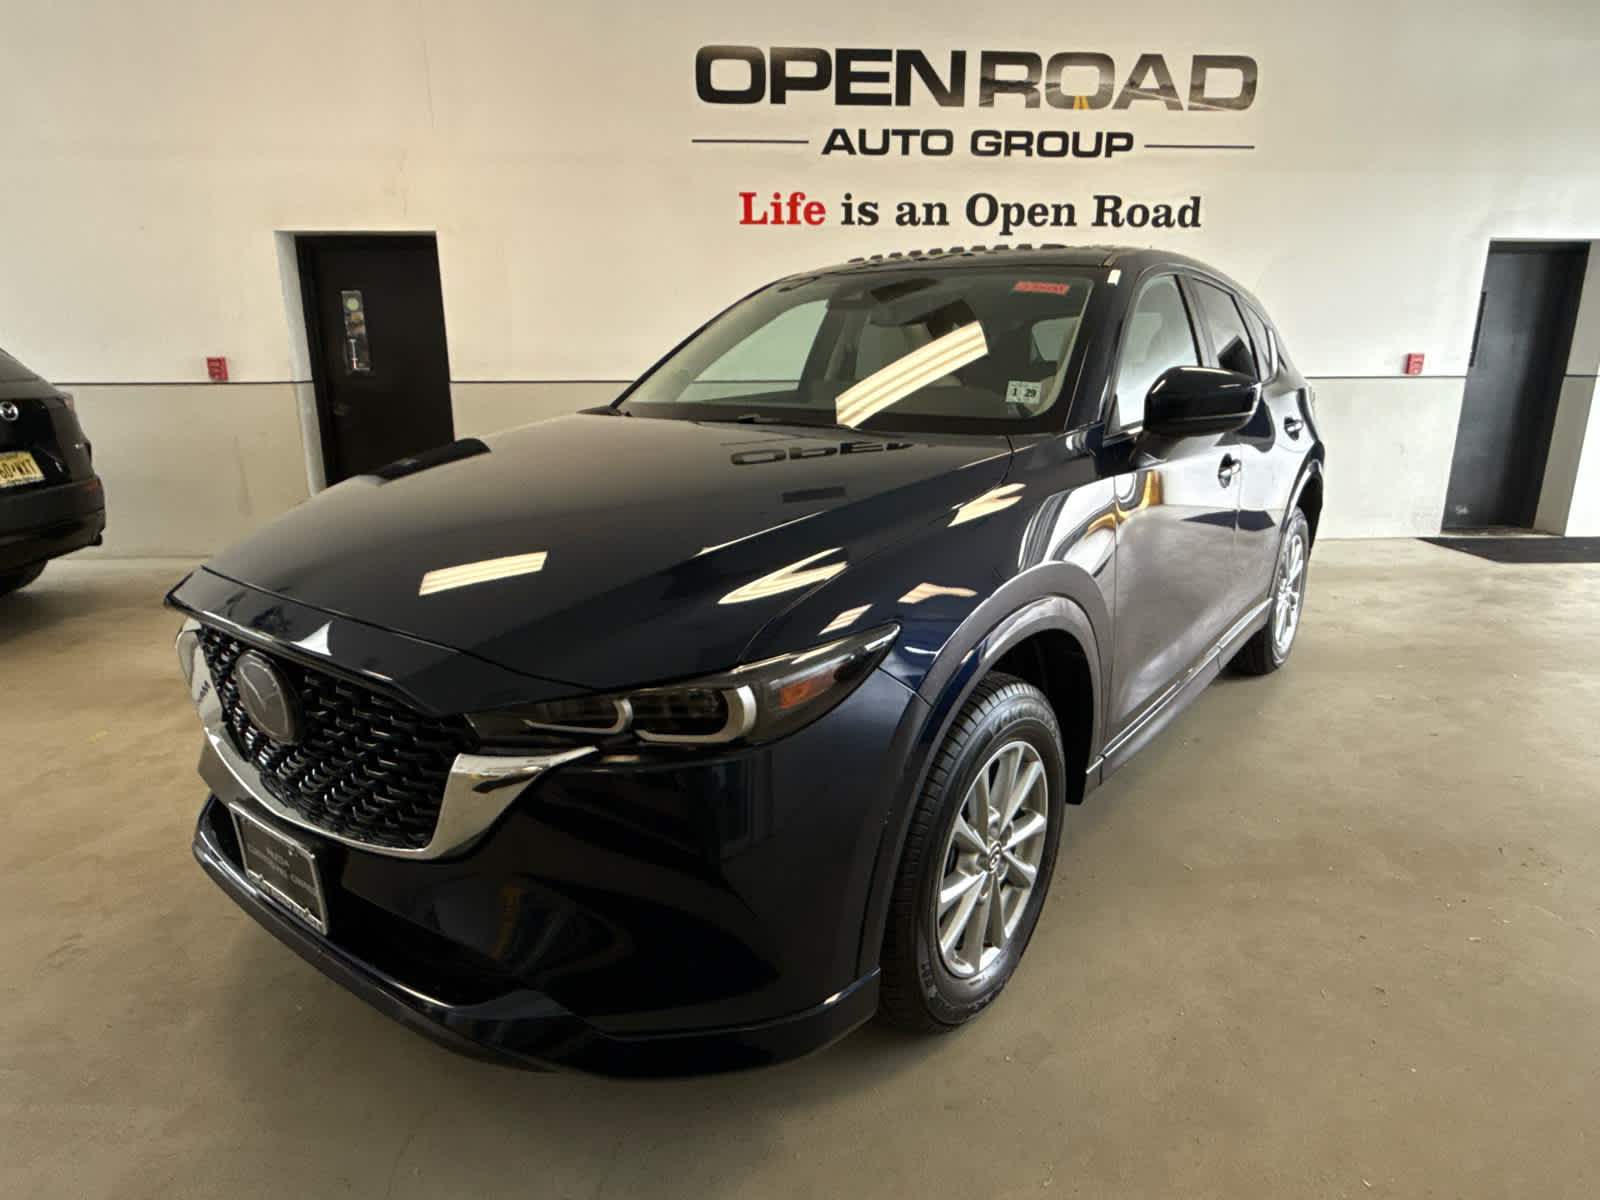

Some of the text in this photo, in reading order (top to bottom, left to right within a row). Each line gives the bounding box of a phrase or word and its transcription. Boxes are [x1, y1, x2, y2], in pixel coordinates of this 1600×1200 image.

[695, 45, 1258, 112] OPEN ROAD
[821, 128, 1134, 158] AUTO GROUP
[739, 192, 1201, 235] Life is an Open Road
